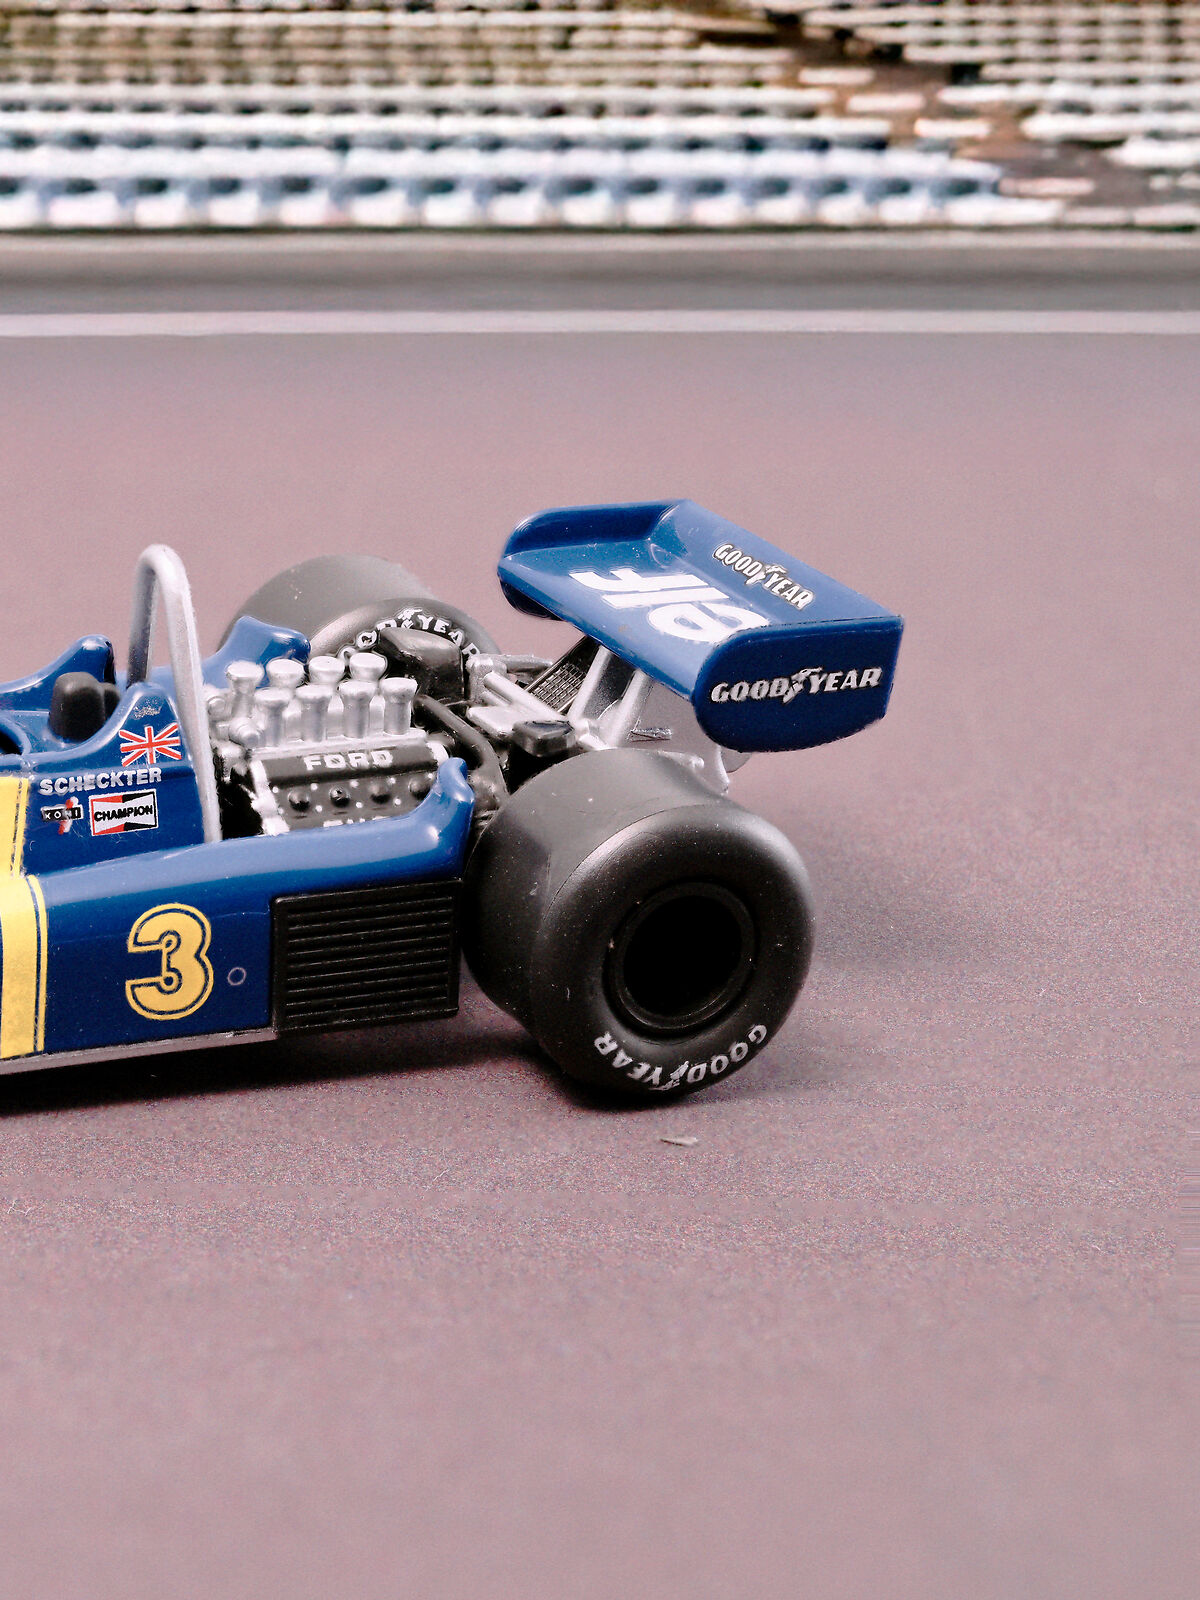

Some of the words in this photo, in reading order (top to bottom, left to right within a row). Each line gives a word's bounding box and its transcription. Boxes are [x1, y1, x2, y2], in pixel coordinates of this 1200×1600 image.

[569, 567, 771, 643] elf
[303, 750, 394, 771] FORD
[39, 767, 162, 795] SCHECKTER
[94, 805, 154, 822] CHAMPION
[125, 902, 214, 1021] 3
